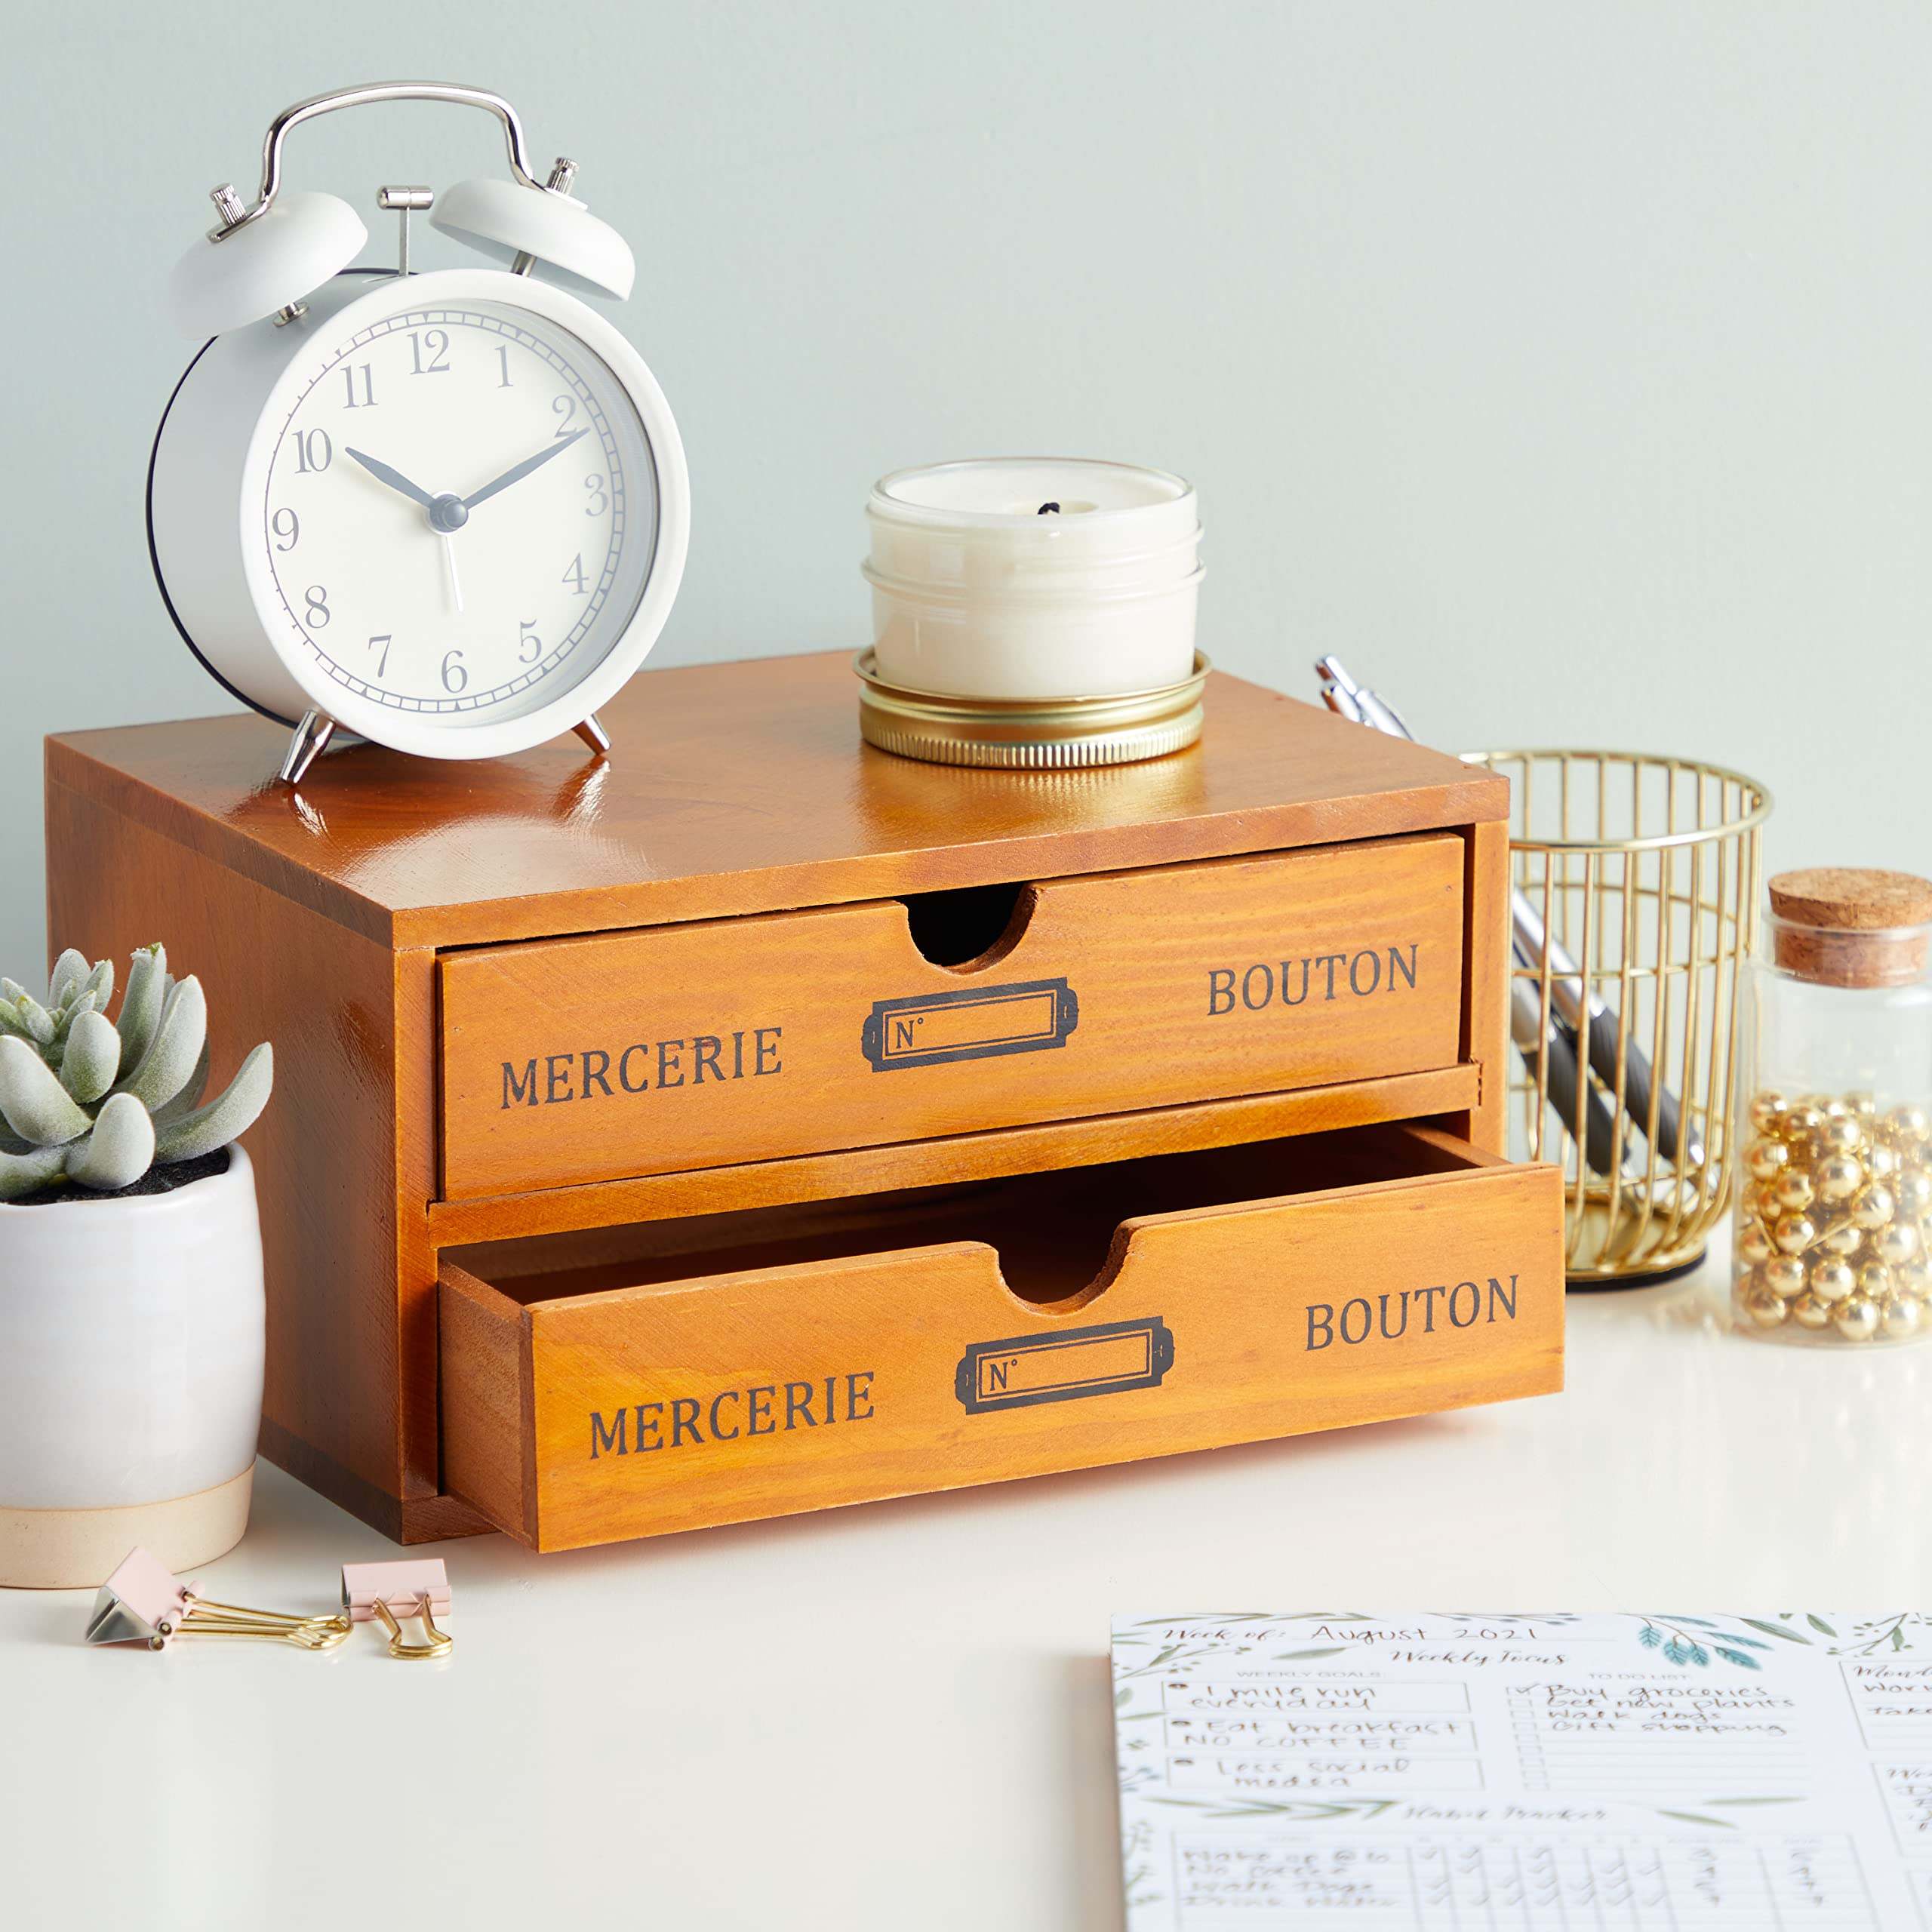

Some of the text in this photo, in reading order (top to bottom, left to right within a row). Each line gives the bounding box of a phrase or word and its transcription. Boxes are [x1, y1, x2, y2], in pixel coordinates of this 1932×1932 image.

[407, 329, 451, 375] 12
[494, 346, 514, 388] 1
[340, 363, 378, 409] 11
[552, 395, 578, 438] 2
[292, 428, 332, 474] 10
[583, 473, 608, 517] 3
[272, 507, 300, 551] 9
[561, 552, 590, 595] 4
[304, 586, 331, 629] 8
[368, 634, 392, 678] 7
[518, 619, 543, 663] 5
[441, 650, 468, 694] 6
[1208, 943, 1419, 1015] BOUTON
[501, 1027, 783, 1109] MERCERIE
[1305, 1275, 1519, 1352] BOUTON
[590, 1371, 874, 1460] MERCERIE
[1310, 1625, 1427, 1645] August
[1453, 1628, 1537, 1640] 2021
[1230, 1686, 1303, 1699] mile
[1317, 1686, 1377, 1699] run
[1546, 1684, 1770, 1703] Buy groceries
[1691, 1697, 1797, 1712] plants
